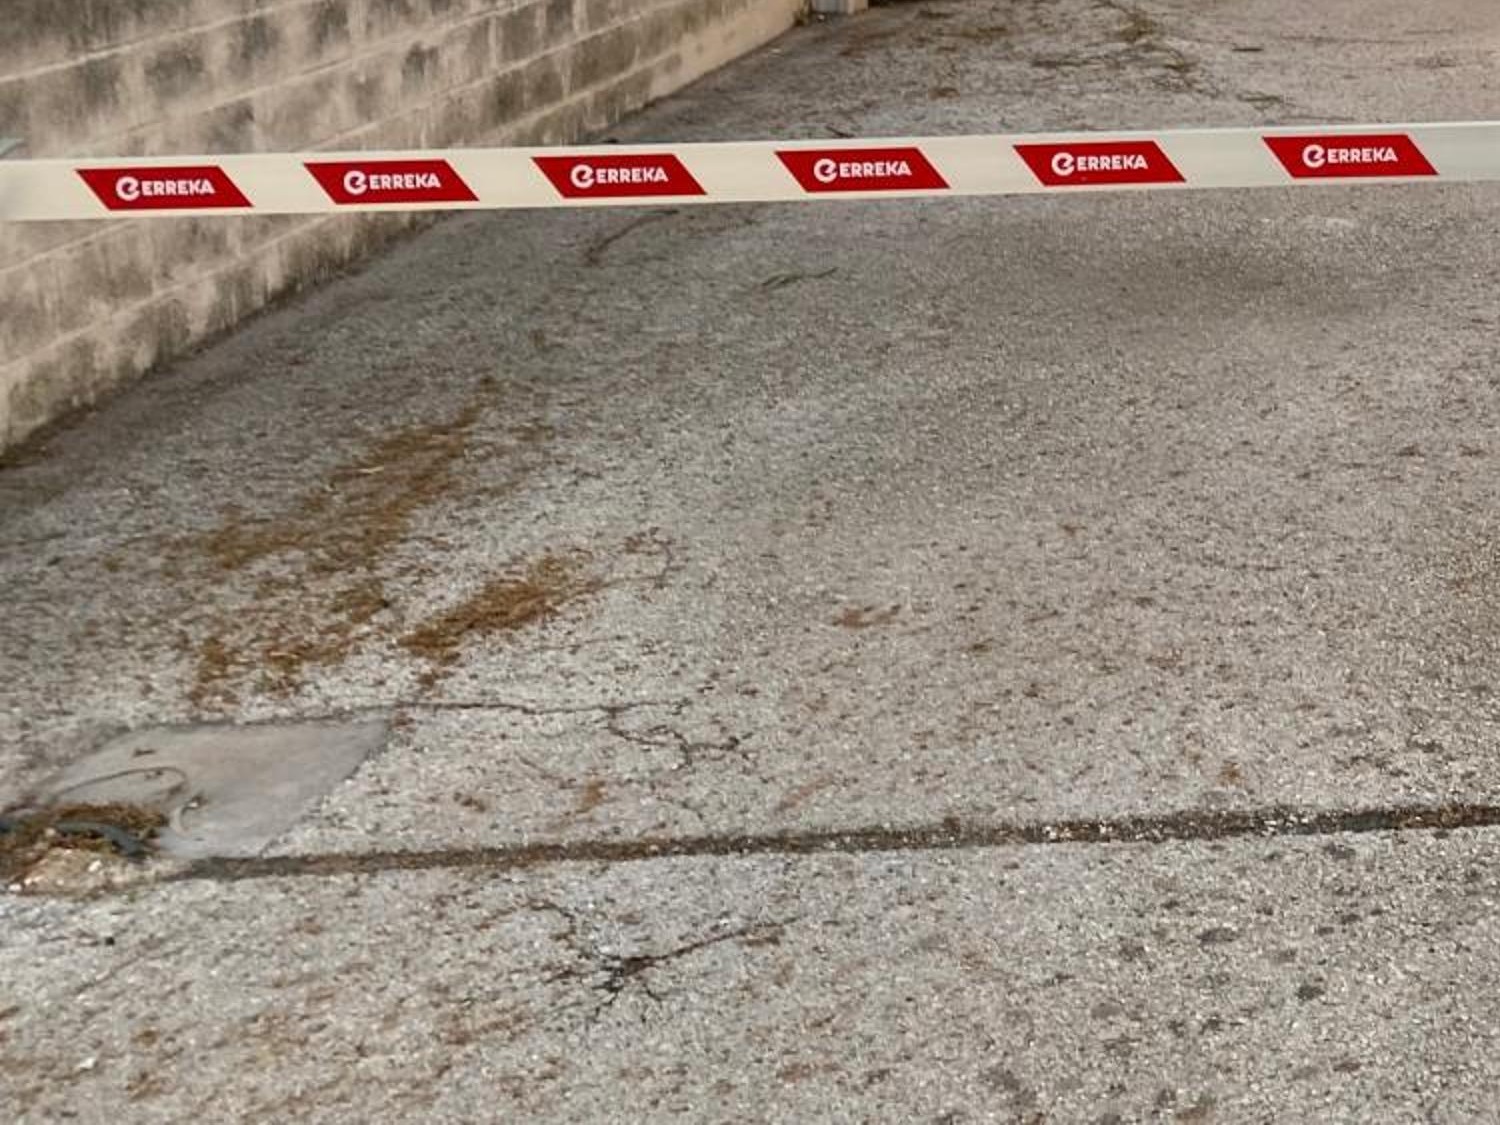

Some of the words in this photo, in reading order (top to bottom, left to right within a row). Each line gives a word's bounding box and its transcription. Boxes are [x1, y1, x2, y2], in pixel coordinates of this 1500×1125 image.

[1075, 153, 1149, 172] ERREKA
[1326, 146, 1399, 165] ERREKA
[595, 166, 670, 185] ERREKA
[838, 160, 913, 179] ERREKA
[140, 178, 216, 197] ERREKA
[368, 172, 442, 191] ERREKA
